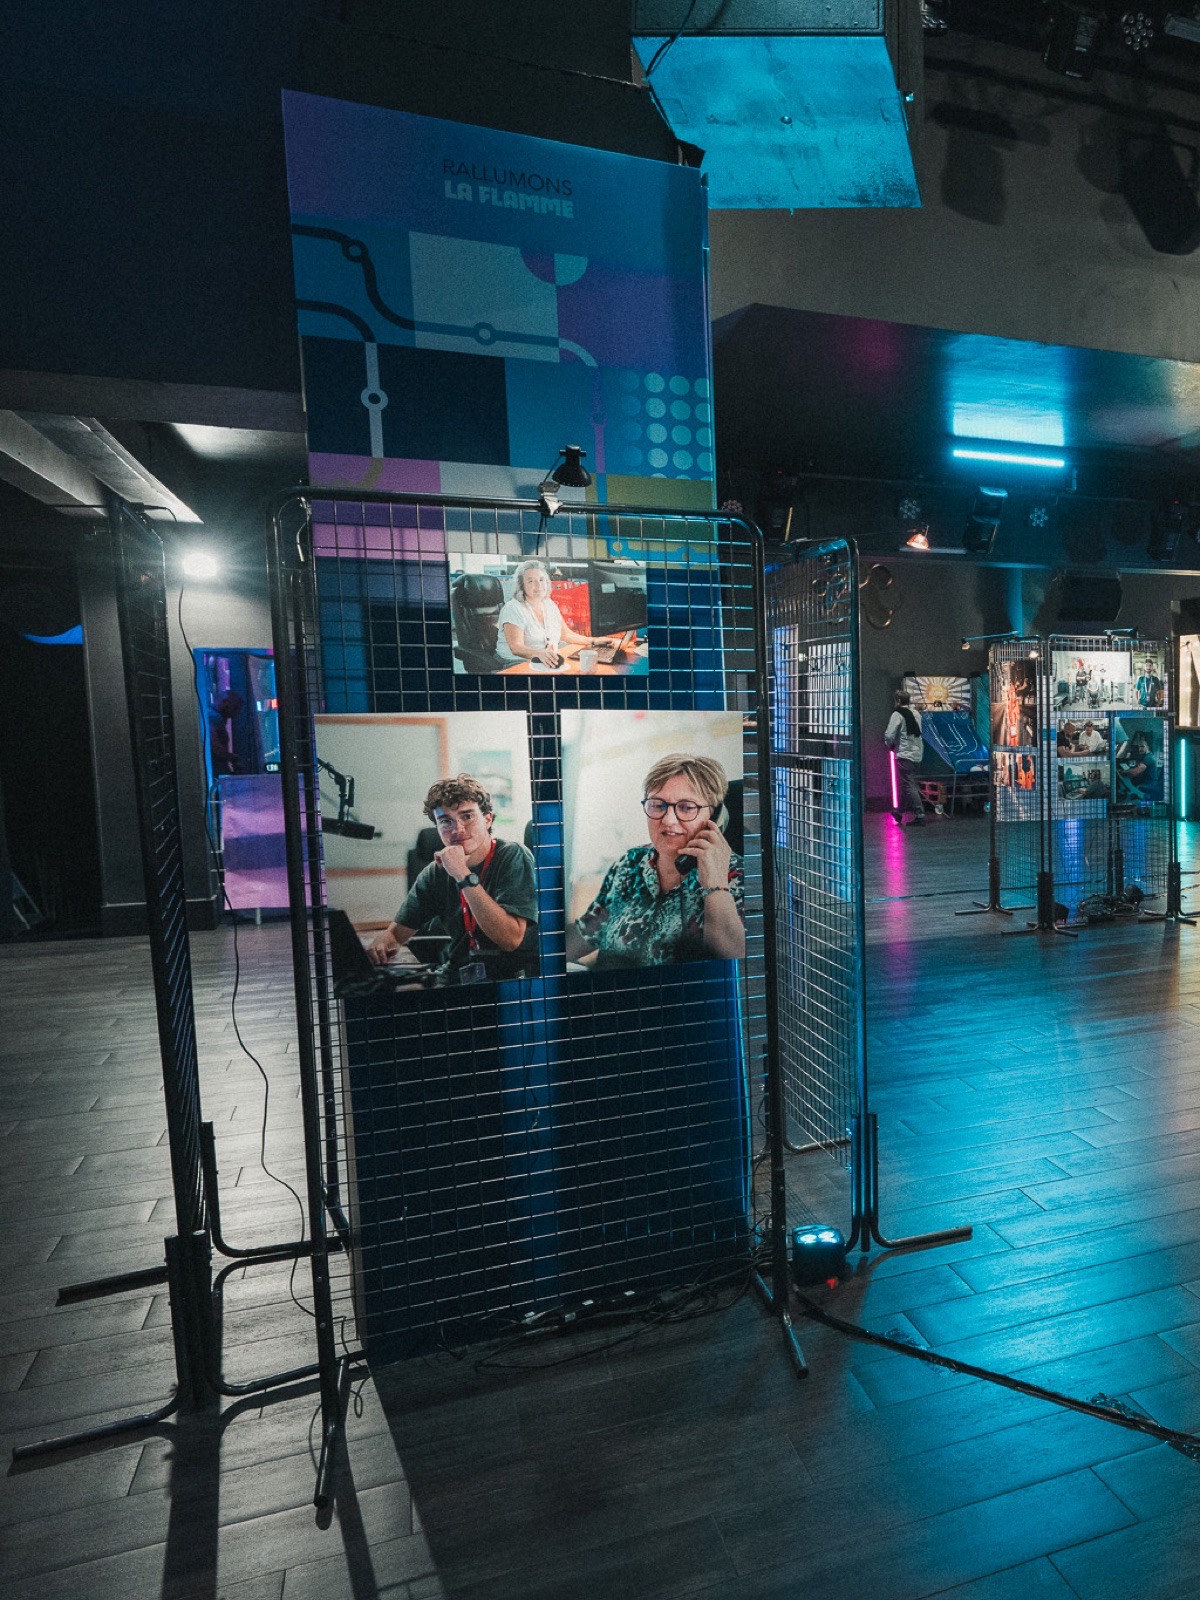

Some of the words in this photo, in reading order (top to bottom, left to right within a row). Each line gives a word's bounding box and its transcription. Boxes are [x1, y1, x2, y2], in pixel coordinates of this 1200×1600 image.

[442, 158, 574, 196] RALLUMONS
[444, 179, 473, 203] LA
[478, 185, 575, 219] FLAMME
